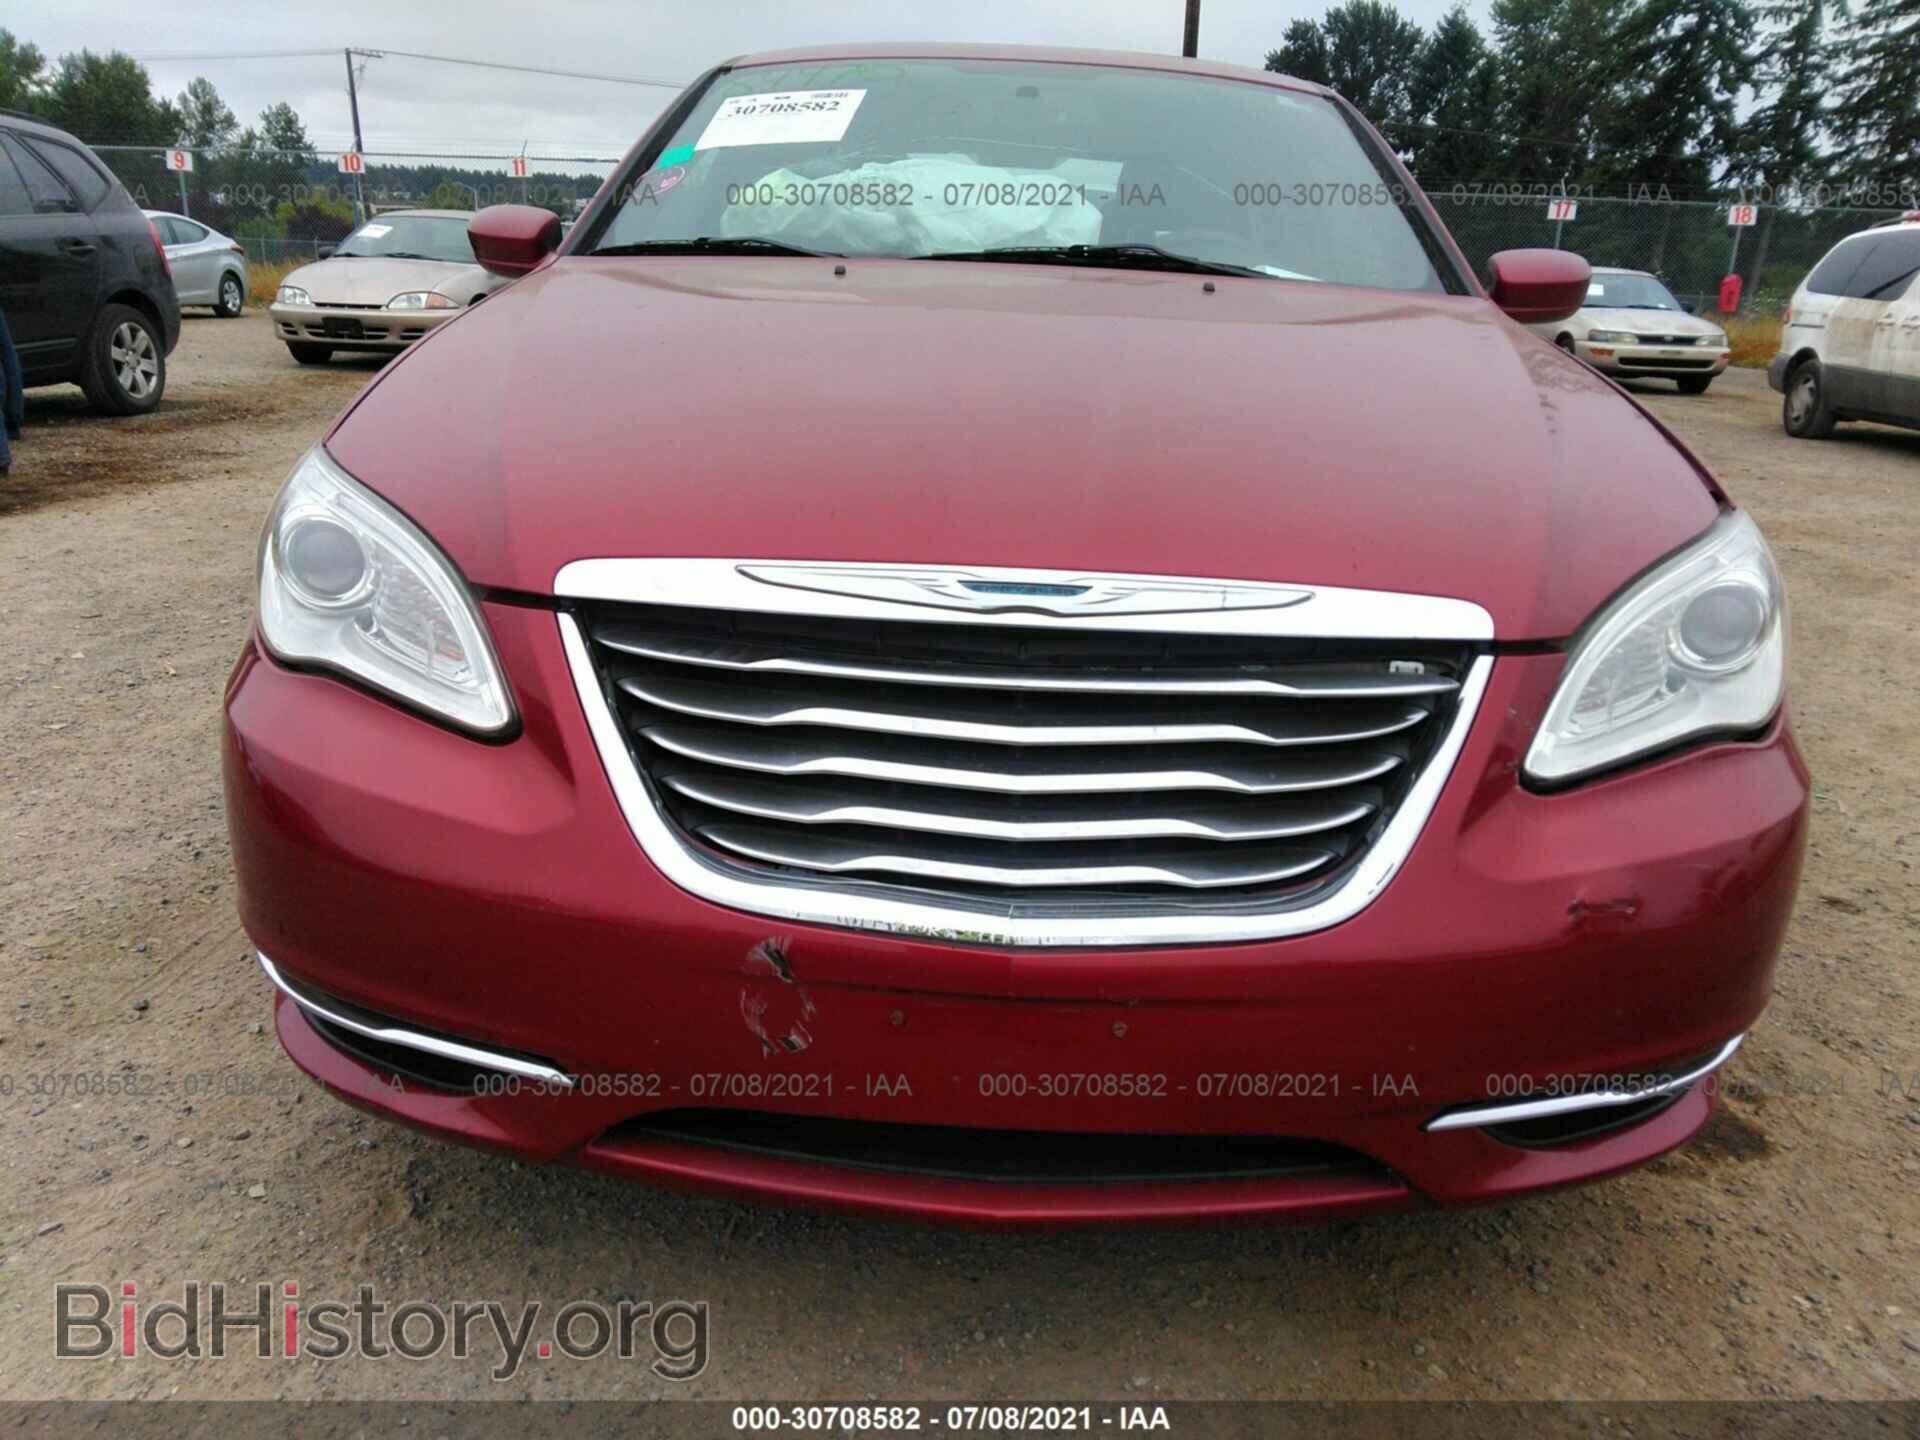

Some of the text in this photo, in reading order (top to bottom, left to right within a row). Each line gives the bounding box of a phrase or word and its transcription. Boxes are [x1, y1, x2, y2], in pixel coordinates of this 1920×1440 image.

[727, 100, 840, 117] 30708582
[175, 151, 184, 169] 9
[341, 153, 361, 171] 10
[512, 159, 526, 175] 11
[1555, 201, 1571, 217] 17
[1733, 207, 1752, 224] 18
